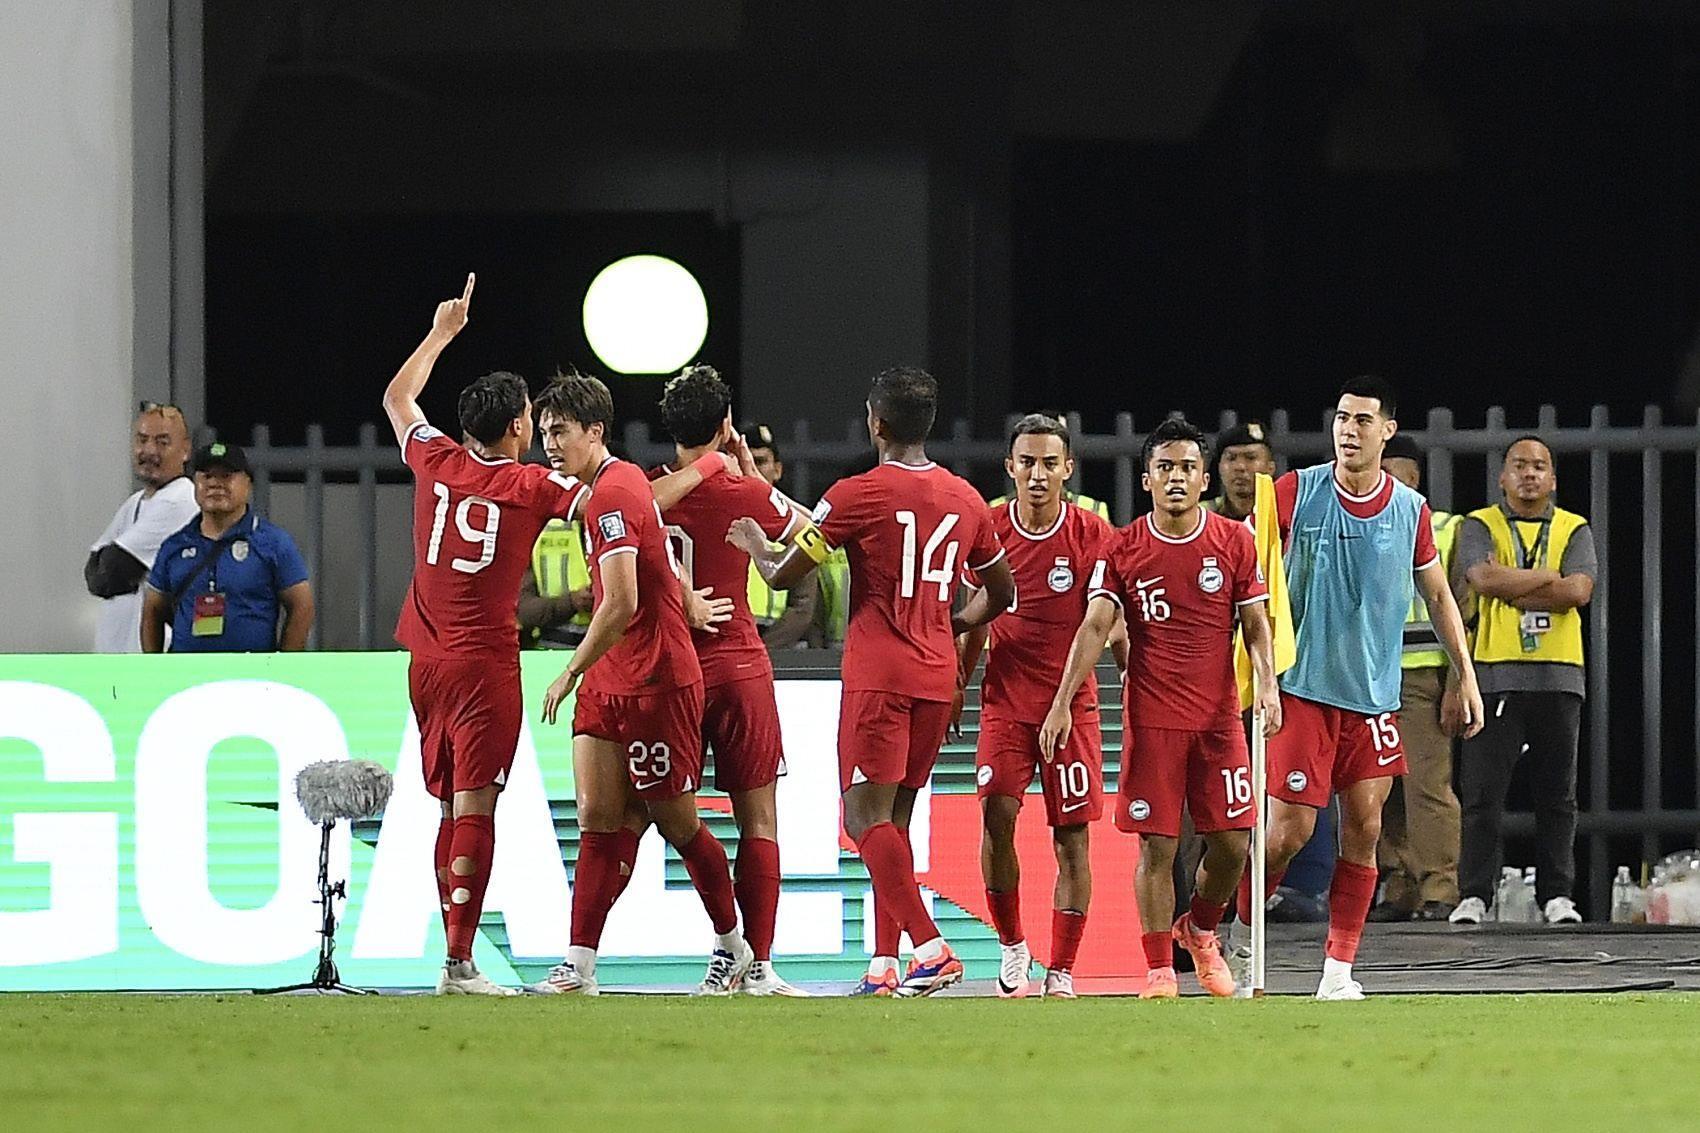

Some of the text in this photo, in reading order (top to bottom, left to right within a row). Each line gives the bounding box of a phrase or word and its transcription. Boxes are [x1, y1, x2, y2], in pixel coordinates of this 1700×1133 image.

[426, 482, 502, 574] 19
[896, 510, 961, 602] 14
[1138, 588, 1171, 621] 16
[1366, 712, 1401, 750] 15
[628, 740, 671, 777] 23
[1056, 762, 1089, 798] 10
[1221, 766, 1252, 804] 16
